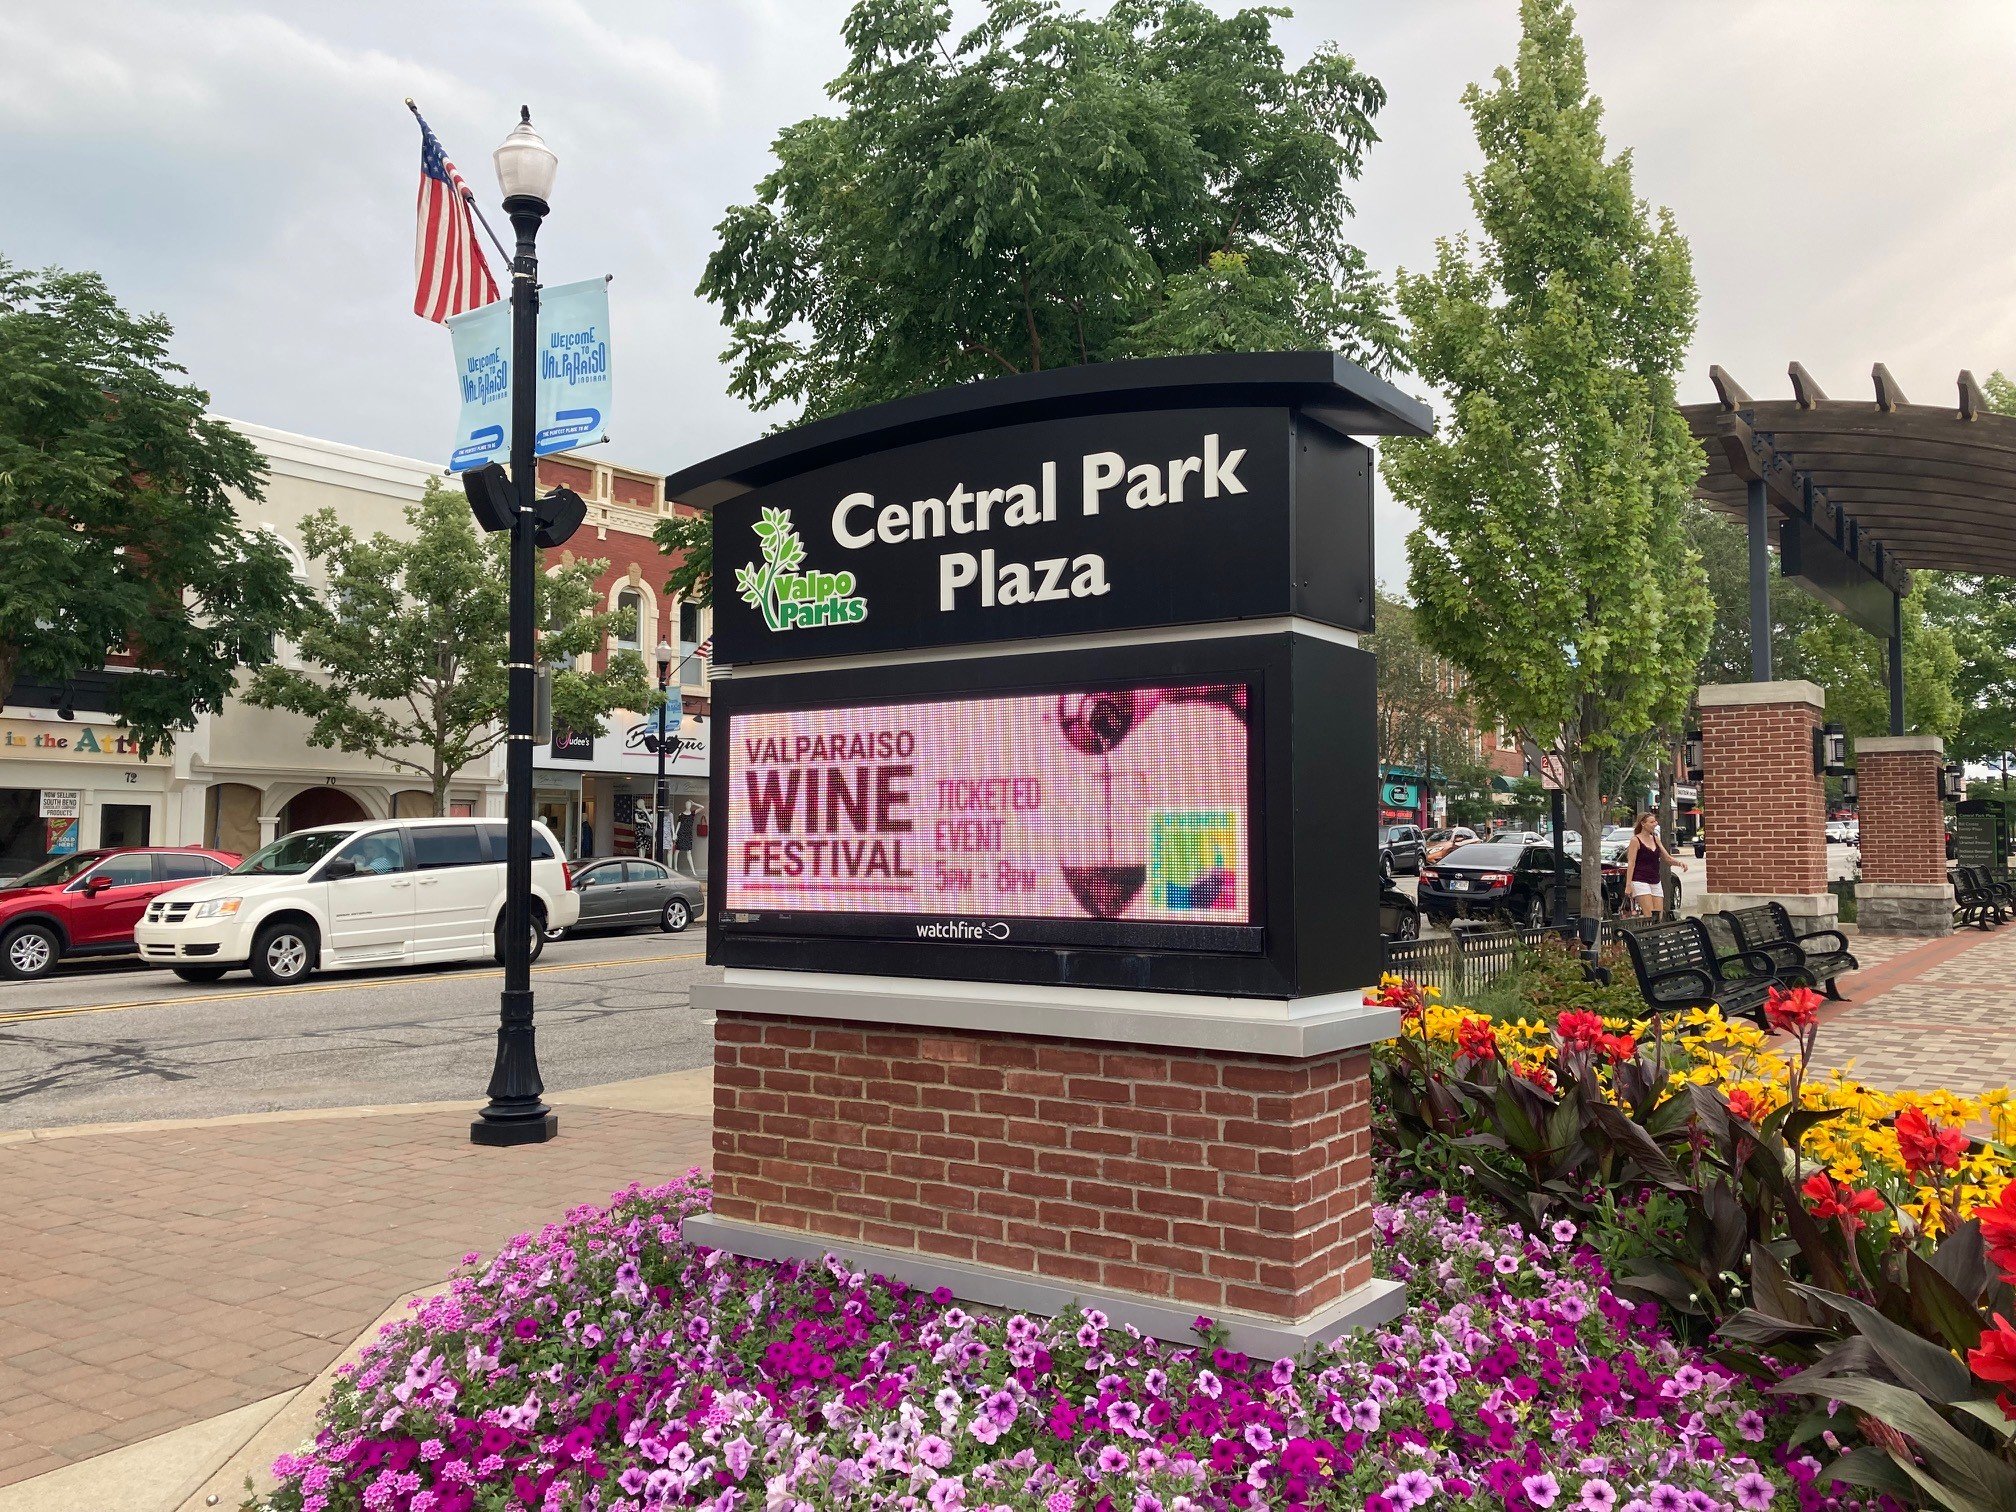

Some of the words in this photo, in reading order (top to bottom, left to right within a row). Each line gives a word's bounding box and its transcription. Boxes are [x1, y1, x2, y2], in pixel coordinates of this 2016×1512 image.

[551, 327, 596, 350] WELCOME
[582, 346, 590, 354] TO
[468, 347, 500, 373] WELCOME
[542, 342, 606, 386] VALPARAISO
[462, 360, 508, 406] VALPARAISO
[577, 374, 607, 384] INDIANA
[831, 461, 1057, 549] Central
[1082, 433, 1248, 516] Park
[774, 570, 857, 602] Valpo
[939, 549, 1111, 612] Plaza
[779, 597, 868, 630] Parks
[5, 732, 26, 746] in
[34, 733, 68, 748] the
[74, 727, 153, 755] Atti
[745, 730, 915, 764] VALPARAISO
[125, 771, 137, 783] 72
[326, 776, 336, 785] 70
[745, 765, 914, 833] WINE
[936, 777, 1041, 811] TICKETED
[936, 819, 1006, 851] EVENT
[743, 839, 914, 878] FESTIVAL
[935, 860, 973, 892] 5PM
[999, 860, 1037, 893] 8PM
[916, 920, 983, 939] watchfire
